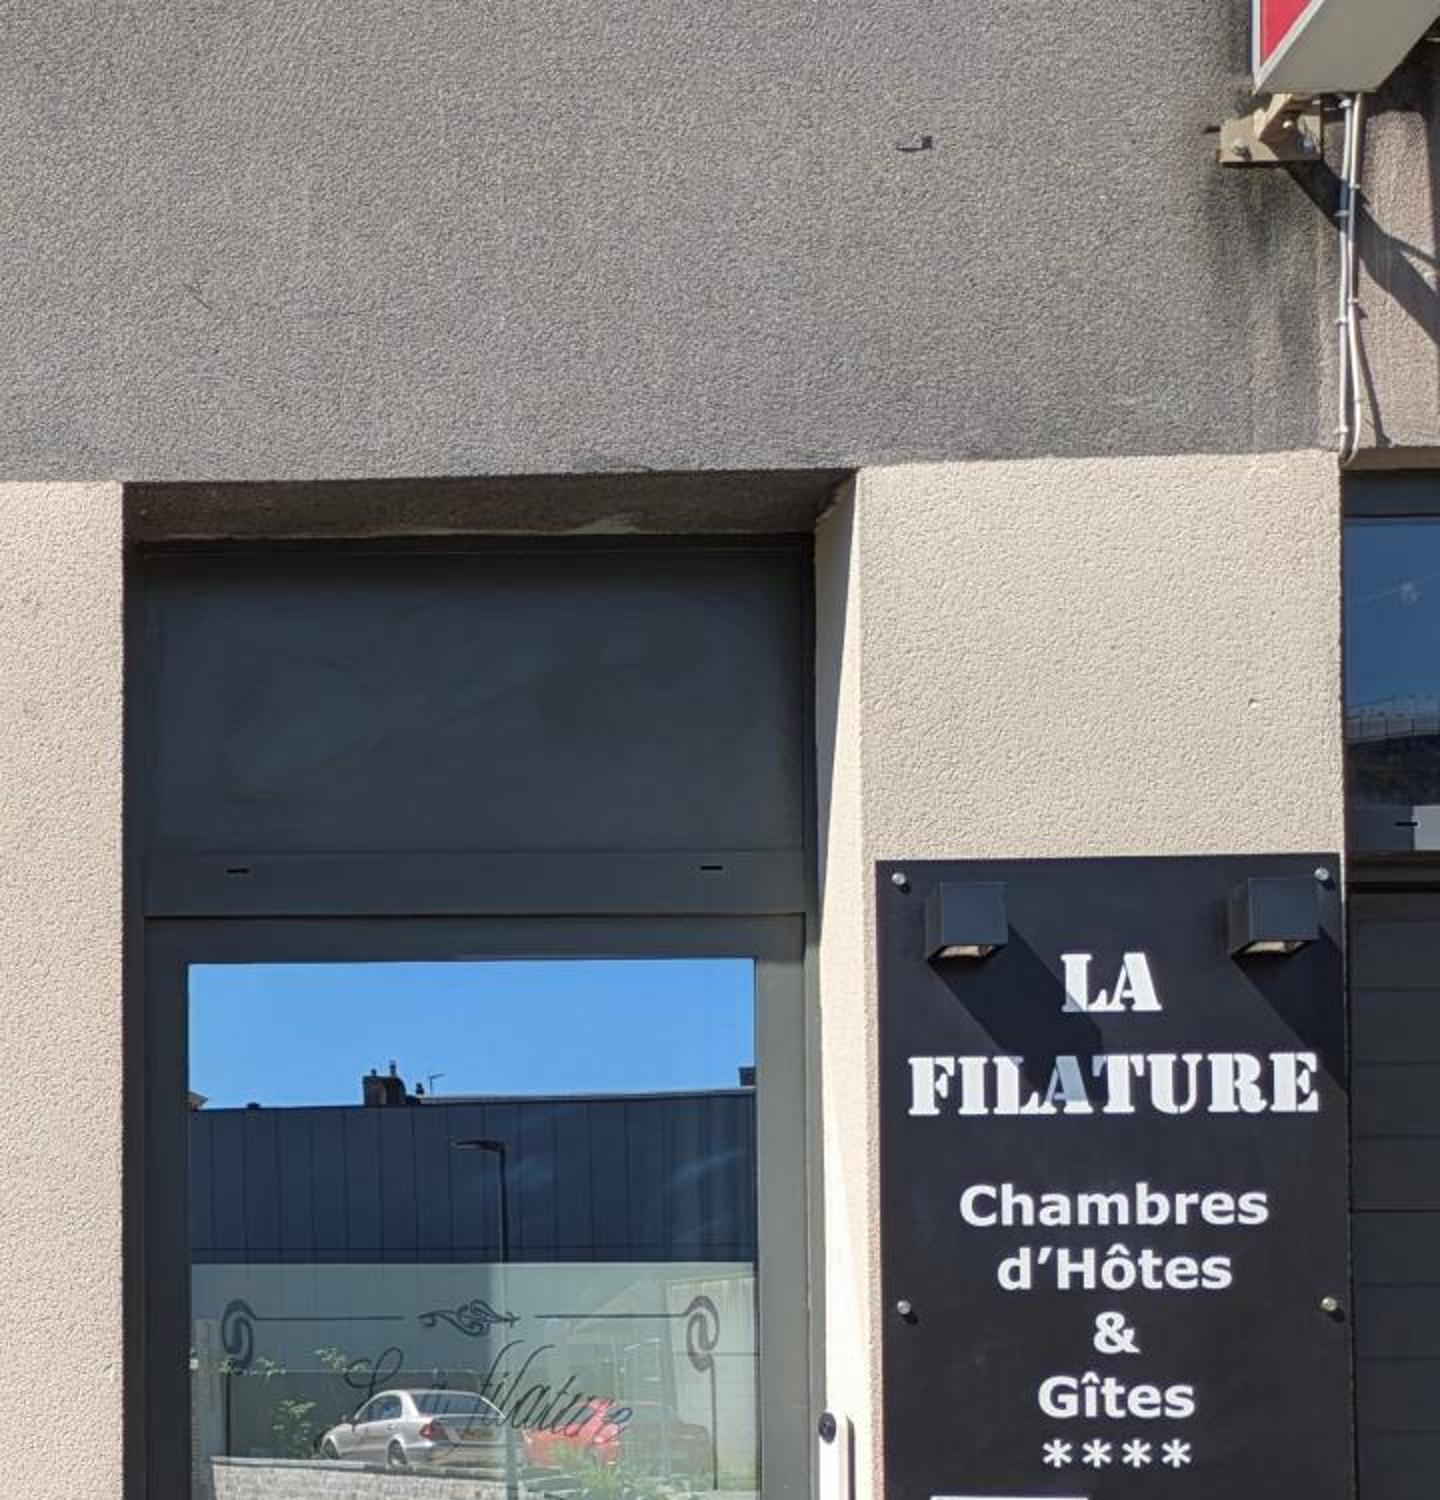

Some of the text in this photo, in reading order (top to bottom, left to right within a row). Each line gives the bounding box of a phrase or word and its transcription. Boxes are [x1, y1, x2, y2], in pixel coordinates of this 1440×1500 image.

[1060, 952, 1162, 1013] LA
[908, 1052, 1320, 1115] FILATURE
[960, 1183, 1269, 1227] Chambres
[1093, 1312, 1140, 1354] &
[1038, 1372, 1196, 1419] Gîtes
